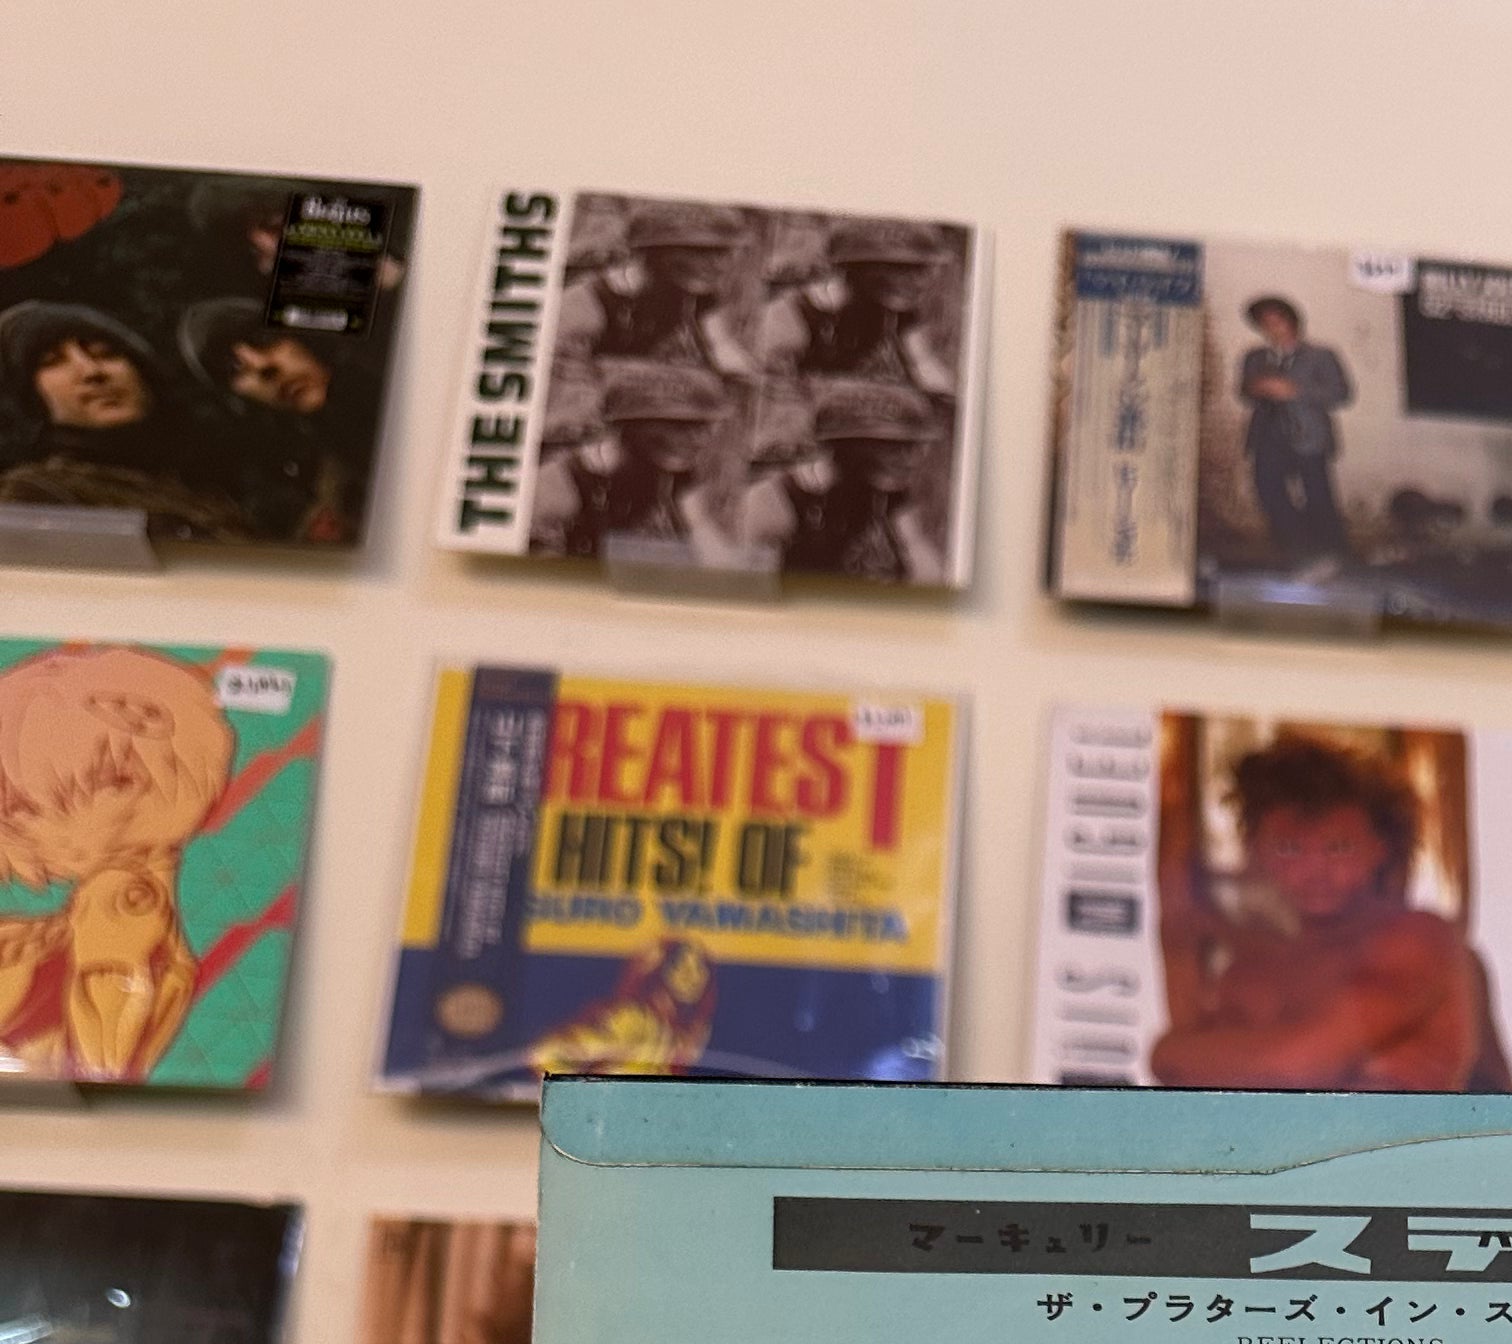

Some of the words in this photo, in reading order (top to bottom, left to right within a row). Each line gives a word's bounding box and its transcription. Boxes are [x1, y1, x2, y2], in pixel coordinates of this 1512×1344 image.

[478, 190, 557, 406] SMITHS
[459, 413, 523, 535] THE
[554, 812, 716, 889] HITS!
[737, 822, 810, 897] OF
[909, 1221, 1151, 1254] マーキュリー
